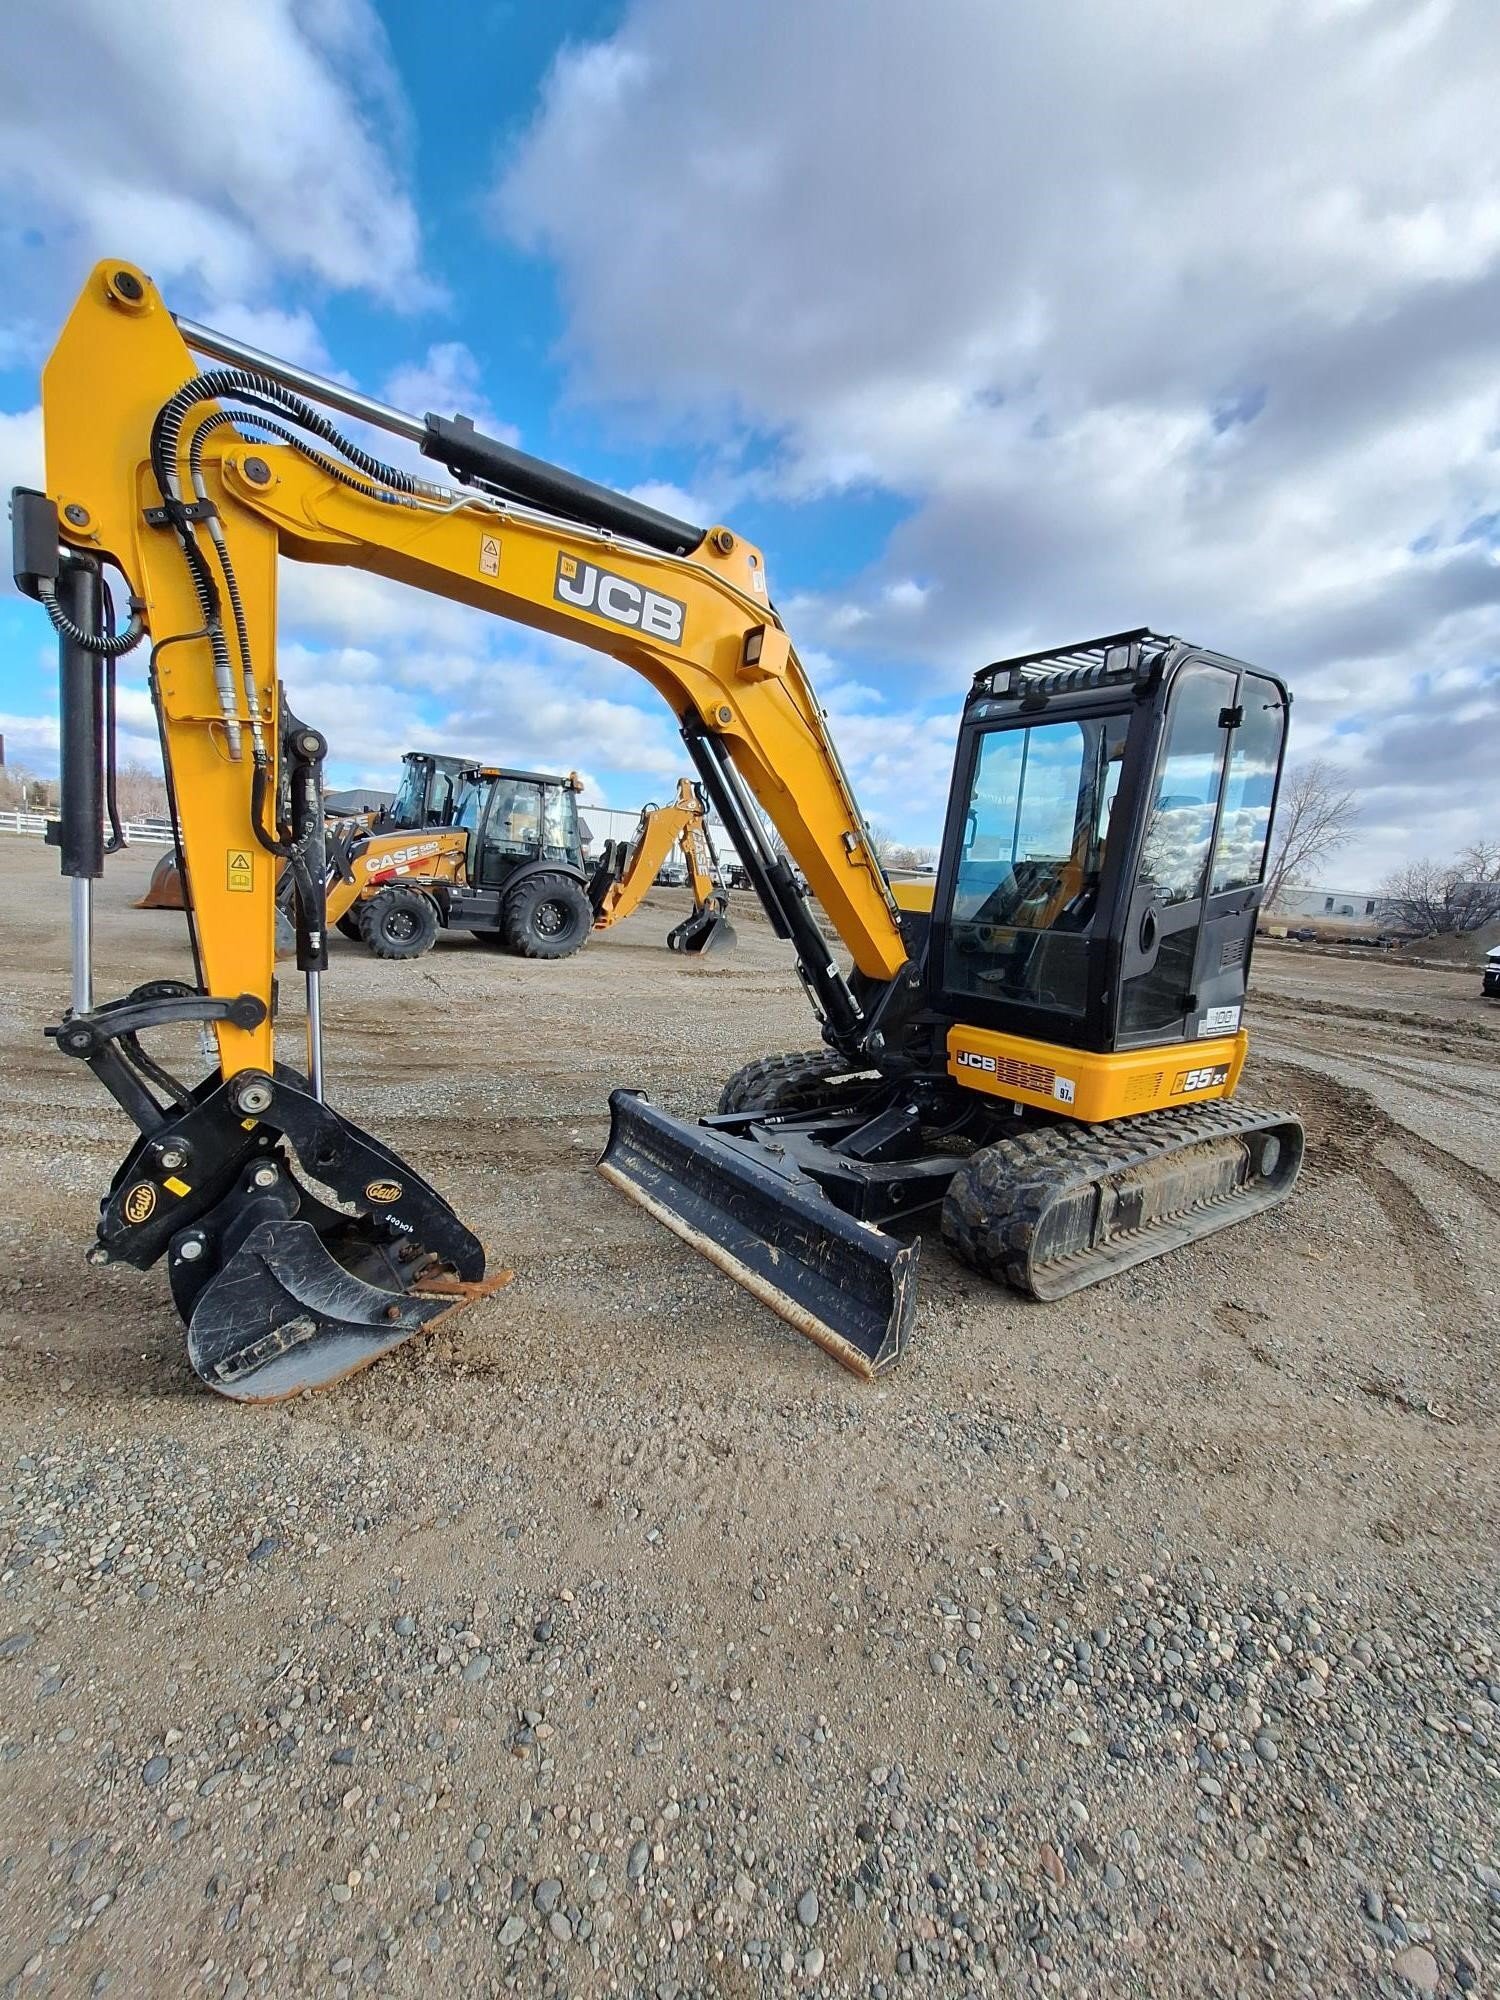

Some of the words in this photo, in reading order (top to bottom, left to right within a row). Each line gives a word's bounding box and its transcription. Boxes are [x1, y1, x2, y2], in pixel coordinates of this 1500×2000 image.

[558, 566, 682, 641] JCB
[366, 846, 419, 872] CASE
[957, 1052, 996, 1072] JCB
